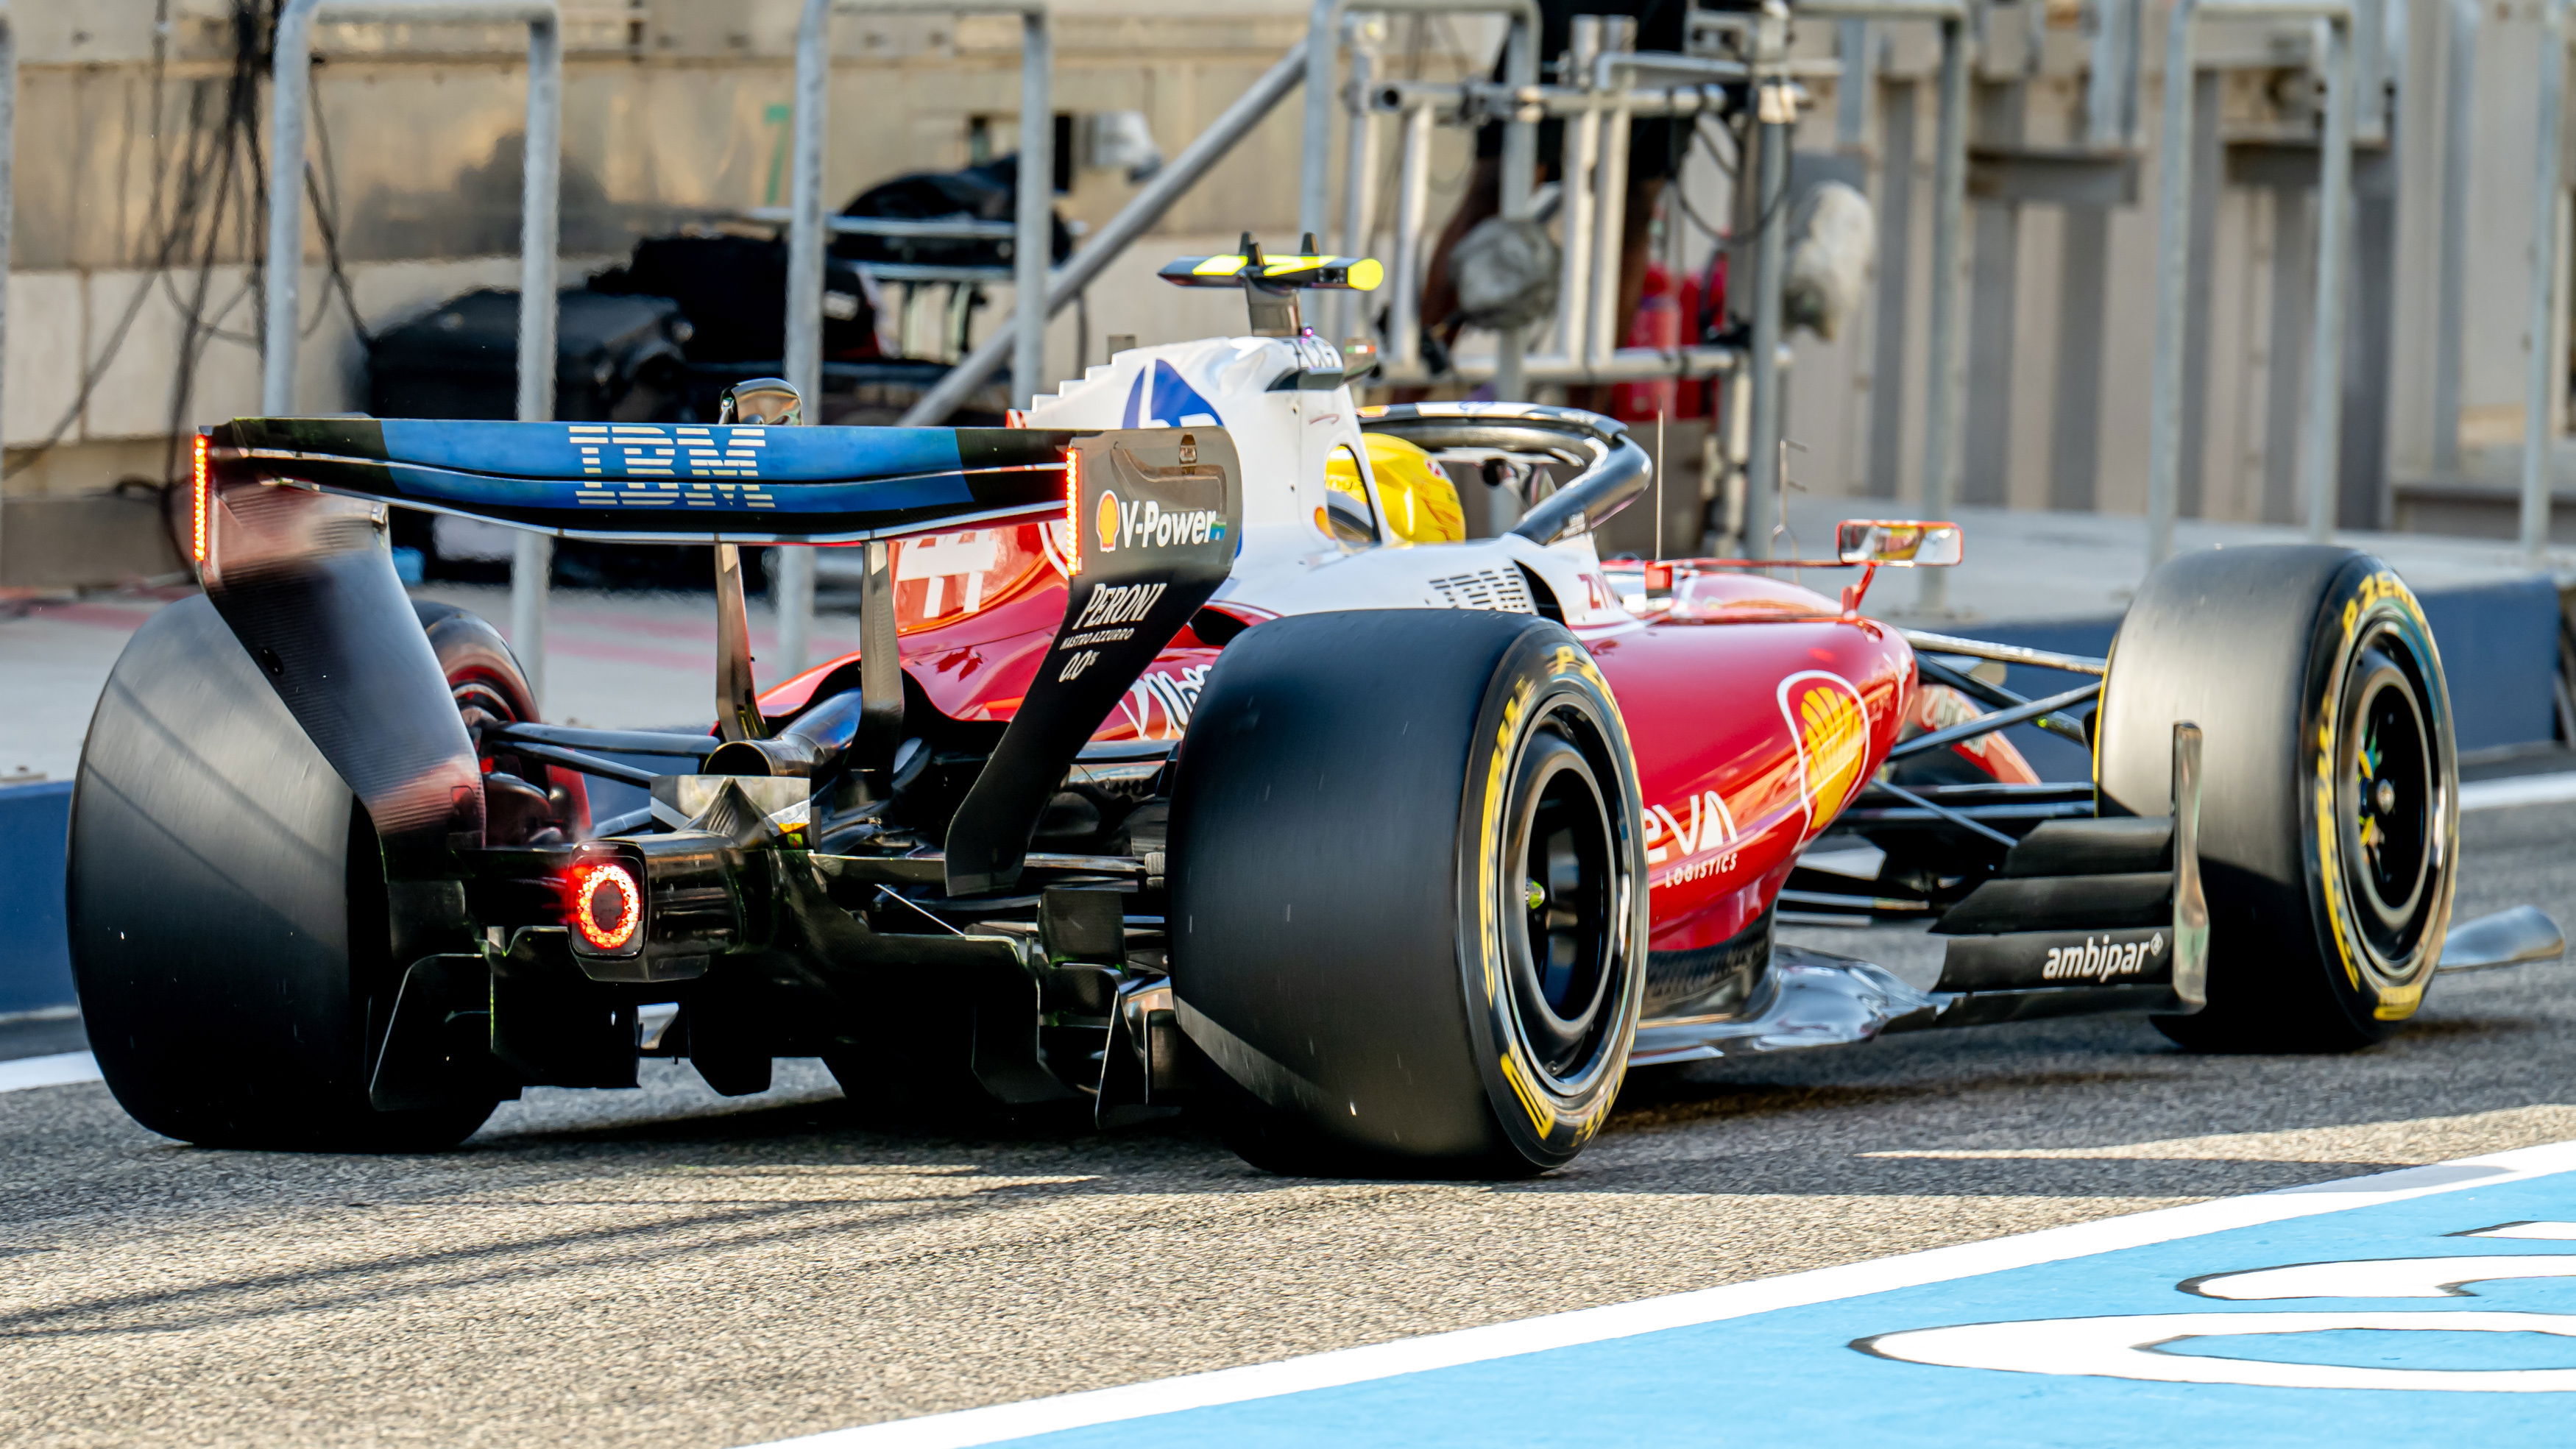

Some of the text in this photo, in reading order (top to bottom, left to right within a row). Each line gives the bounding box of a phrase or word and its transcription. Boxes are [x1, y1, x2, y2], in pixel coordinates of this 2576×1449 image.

[568, 425, 776, 509] IBM
[1119, 500, 1217, 549] V-Power
[1072, 583, 1168, 631] PERONI
[1058, 627, 1135, 651] NASTRO AZZURRO
[1664, 851, 1738, 889] LOGISTICS
[2042, 933, 2151, 983] ambipar
